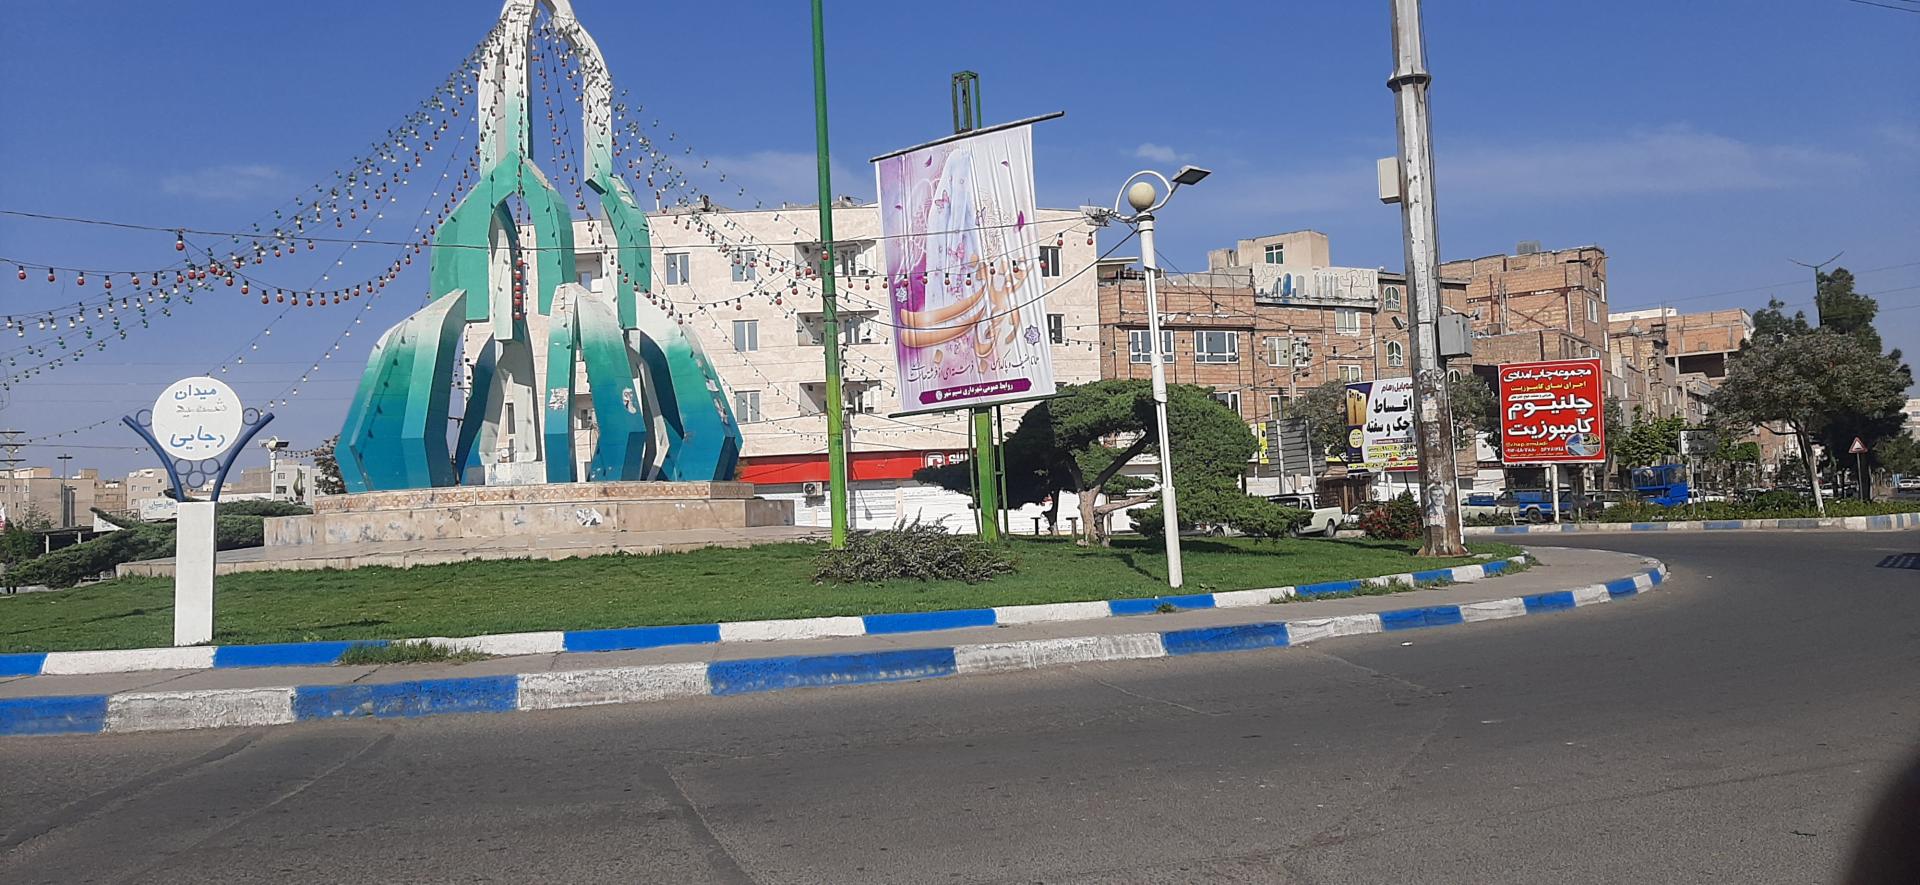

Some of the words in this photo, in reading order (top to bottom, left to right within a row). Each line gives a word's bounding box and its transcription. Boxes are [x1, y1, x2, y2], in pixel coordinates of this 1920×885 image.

[1532, 367, 1555, 382] چاپ
[1555, 367, 1592, 381] مجموعه
[174, 384, 217, 400] میدان
[962, 385, 983, 396] شهرداری
[983, 384, 999, 393] عمومی
[999, 381, 1014, 391] روابط
[1510, 383, 1544, 393] کامپوزیت
[1563, 380, 1587, 390] اجرای
[1373, 394, 1412, 414] اقساط
[1508, 393, 1594, 420] چلنیوم
[1366, 418, 1384, 433] سفته
[1385, 423, 1391, 437] و
[1507, 417, 1595, 441] کامپوزیت
[170, 425, 226, 450] رجایی
